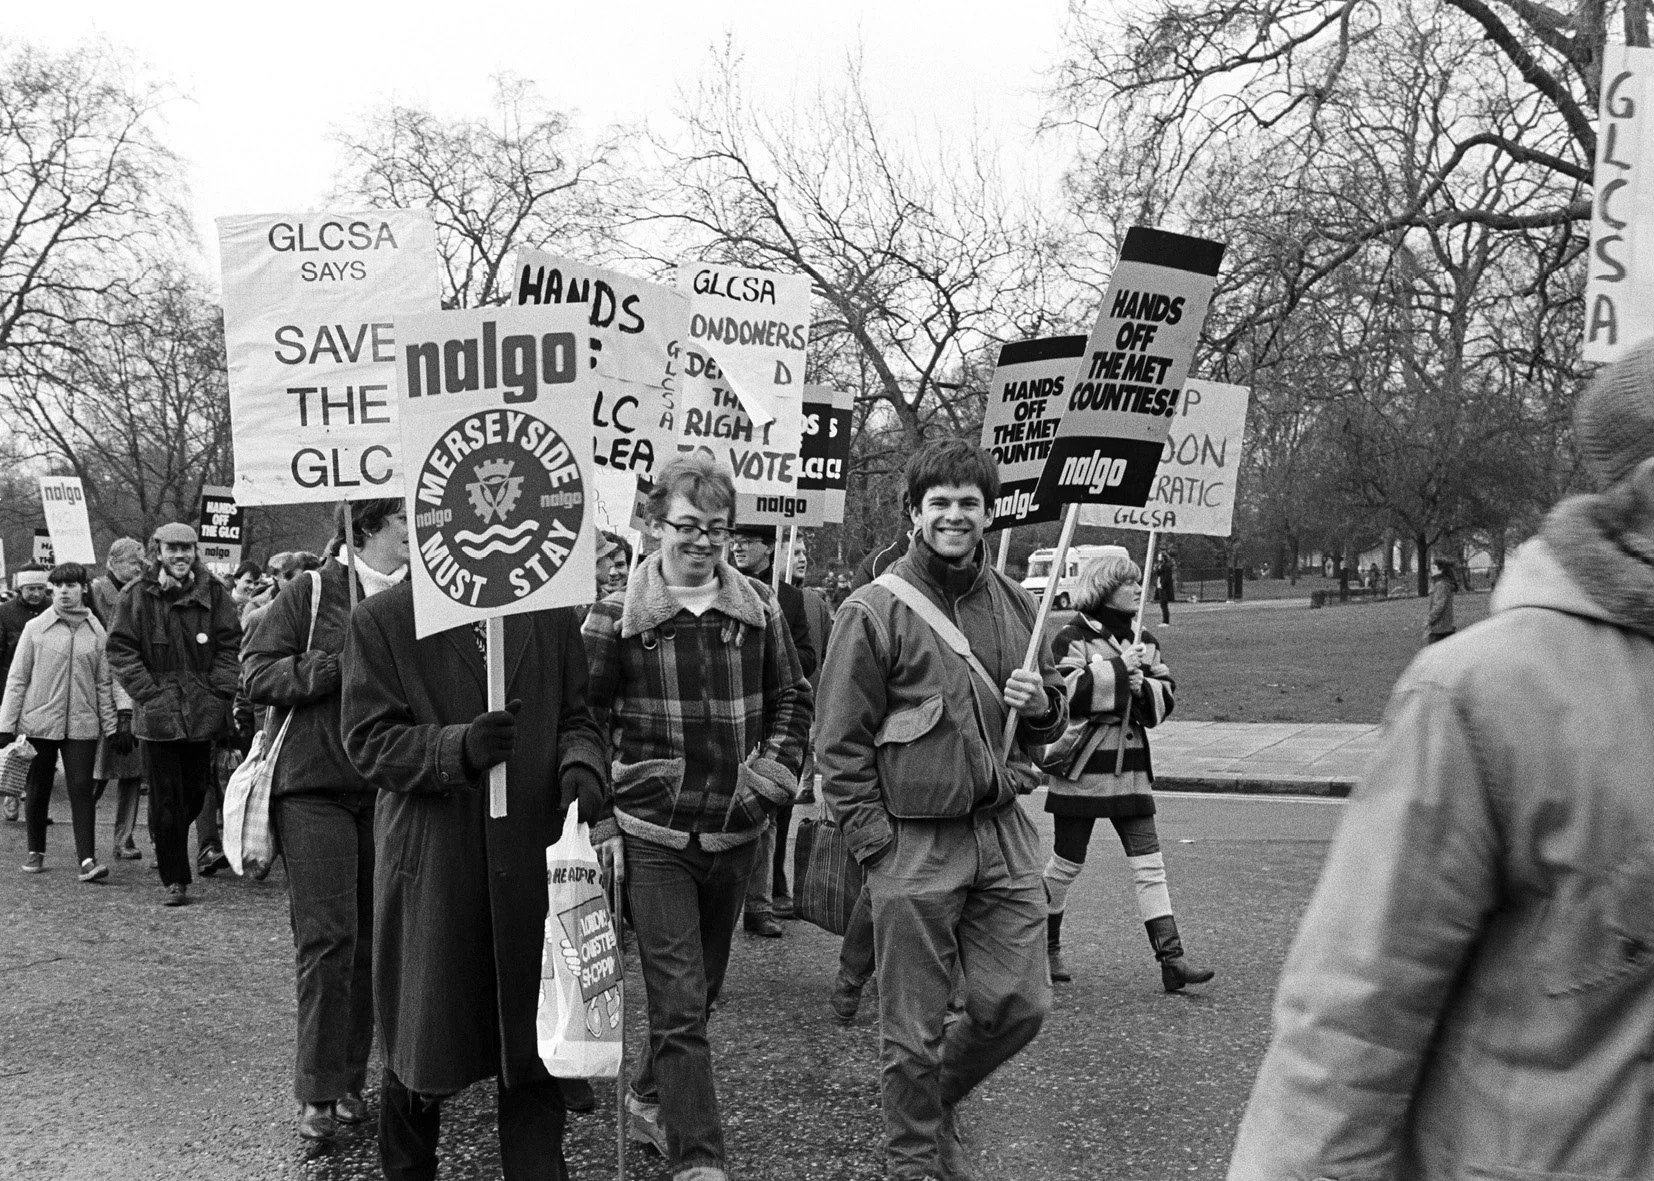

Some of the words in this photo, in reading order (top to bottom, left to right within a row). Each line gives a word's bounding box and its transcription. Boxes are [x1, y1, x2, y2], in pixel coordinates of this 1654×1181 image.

[1589, 71, 1635, 345] GLCSA
[268, 221, 399, 251] GLCSA
[301, 261, 367, 281] SAYS
[693, 269, 776, 305] GLCSA
[518, 264, 645, 334] HANDS
[1110, 289, 1187, 325] HANDS
[274, 323, 396, 364] SAVE
[690, 313, 805, 350] ONDONERS
[1116, 321, 1159, 352] OFF
[406, 321, 577, 404] nalgo
[1088, 351, 1127, 380] THE
[1121, 353, 1174, 385] MET
[287, 385, 390, 426] THE
[1002, 376, 1065, 402] HANDS
[1068, 382, 1180, 418] COUNTIES!
[593, 391, 639, 433] LC
[684, 407, 777, 446] RIGHT
[1014, 399, 1047, 421] OFF
[994, 422, 1026, 445] THE
[1025, 418, 1062, 441] MET
[291, 446, 393, 488] GLC
[418, 411, 580, 507] MERSEYSIDE
[729, 447, 797, 483] VOTE
[1058, 449, 1127, 494] nalgo
[44, 482, 82, 505] nalgo
[206, 501, 238, 515] HANDS
[540, 491, 583, 509] nalgo
[756, 496, 807, 518] nalgo
[201, 525, 218, 537] THE
[212, 514, 230, 526] OFF
[416, 508, 452, 528] nalgo
[1114, 507, 1176, 528] GLCSA
[205, 547, 230, 559] nalgo
[420, 531, 488, 606] MUST
[509, 518, 578, 598] STAY
